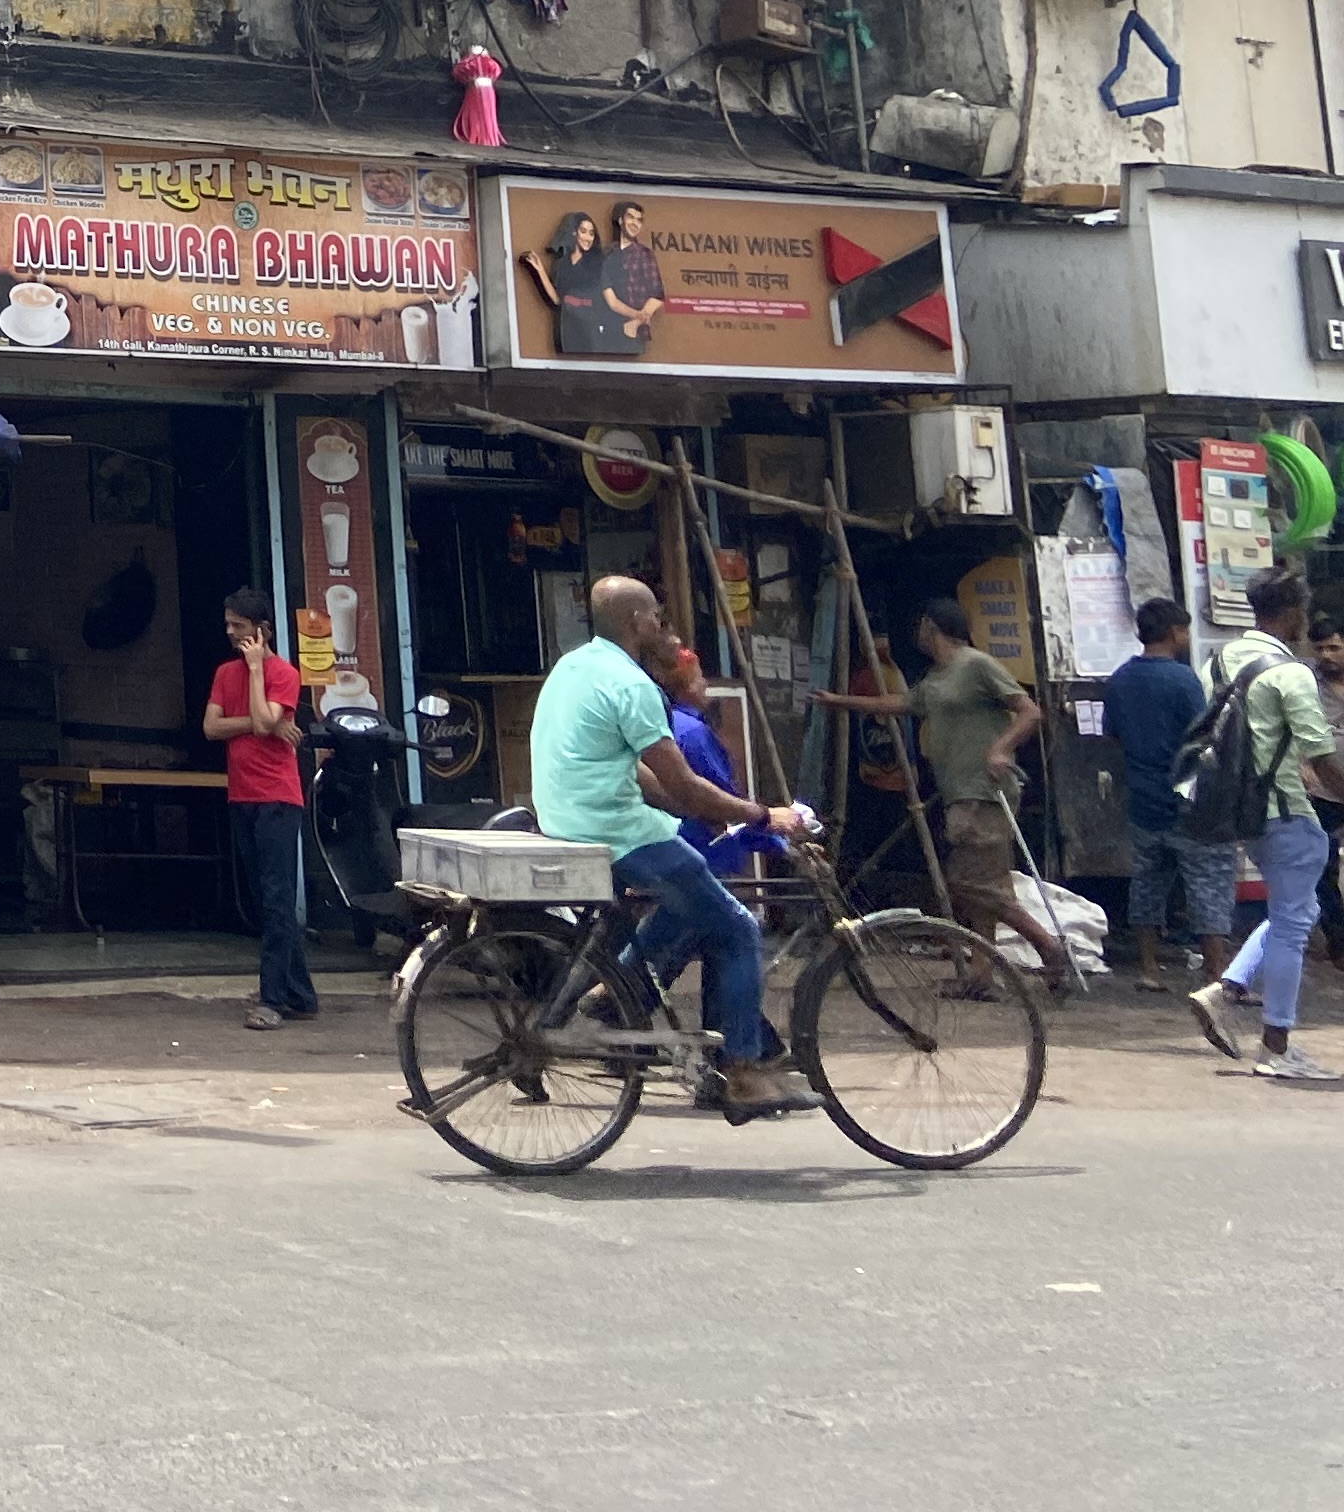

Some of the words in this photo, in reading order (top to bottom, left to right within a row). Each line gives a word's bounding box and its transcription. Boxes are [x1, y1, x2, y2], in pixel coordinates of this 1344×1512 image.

[114, 157, 235, 212] मथुरा
[52, 197, 78, 207] Chicken
[13, 213, 240, 282] MATHURA
[253, 227, 457, 292] BHAWAN
[651, 231, 739, 255] KALYANI
[745, 235, 813, 258] WINES
[680, 263, 739, 288] कल्याणी
[191, 293, 289, 315] CHINESE
[151, 313, 200, 333] VEG.
[206, 315, 223, 335] &
[230, 316, 276, 338] NON
[283, 319, 331, 339] VEG.
[98, 338, 120, 350] 14th
[122, 339, 145, 352] Gali,
[147, 340, 210, 355] Kamathipura
[212, 343, 247, 357] Corner,
[273, 347, 308, 358] Nimkar
[405, 445, 423, 465] AKE
[427, 446, 447, 466] THE
[450, 448, 485, 469] SMART
[325, 484, 345, 495] TEA
[328, 568, 351, 577] MILK
[423, 717, 476, 743] Black
